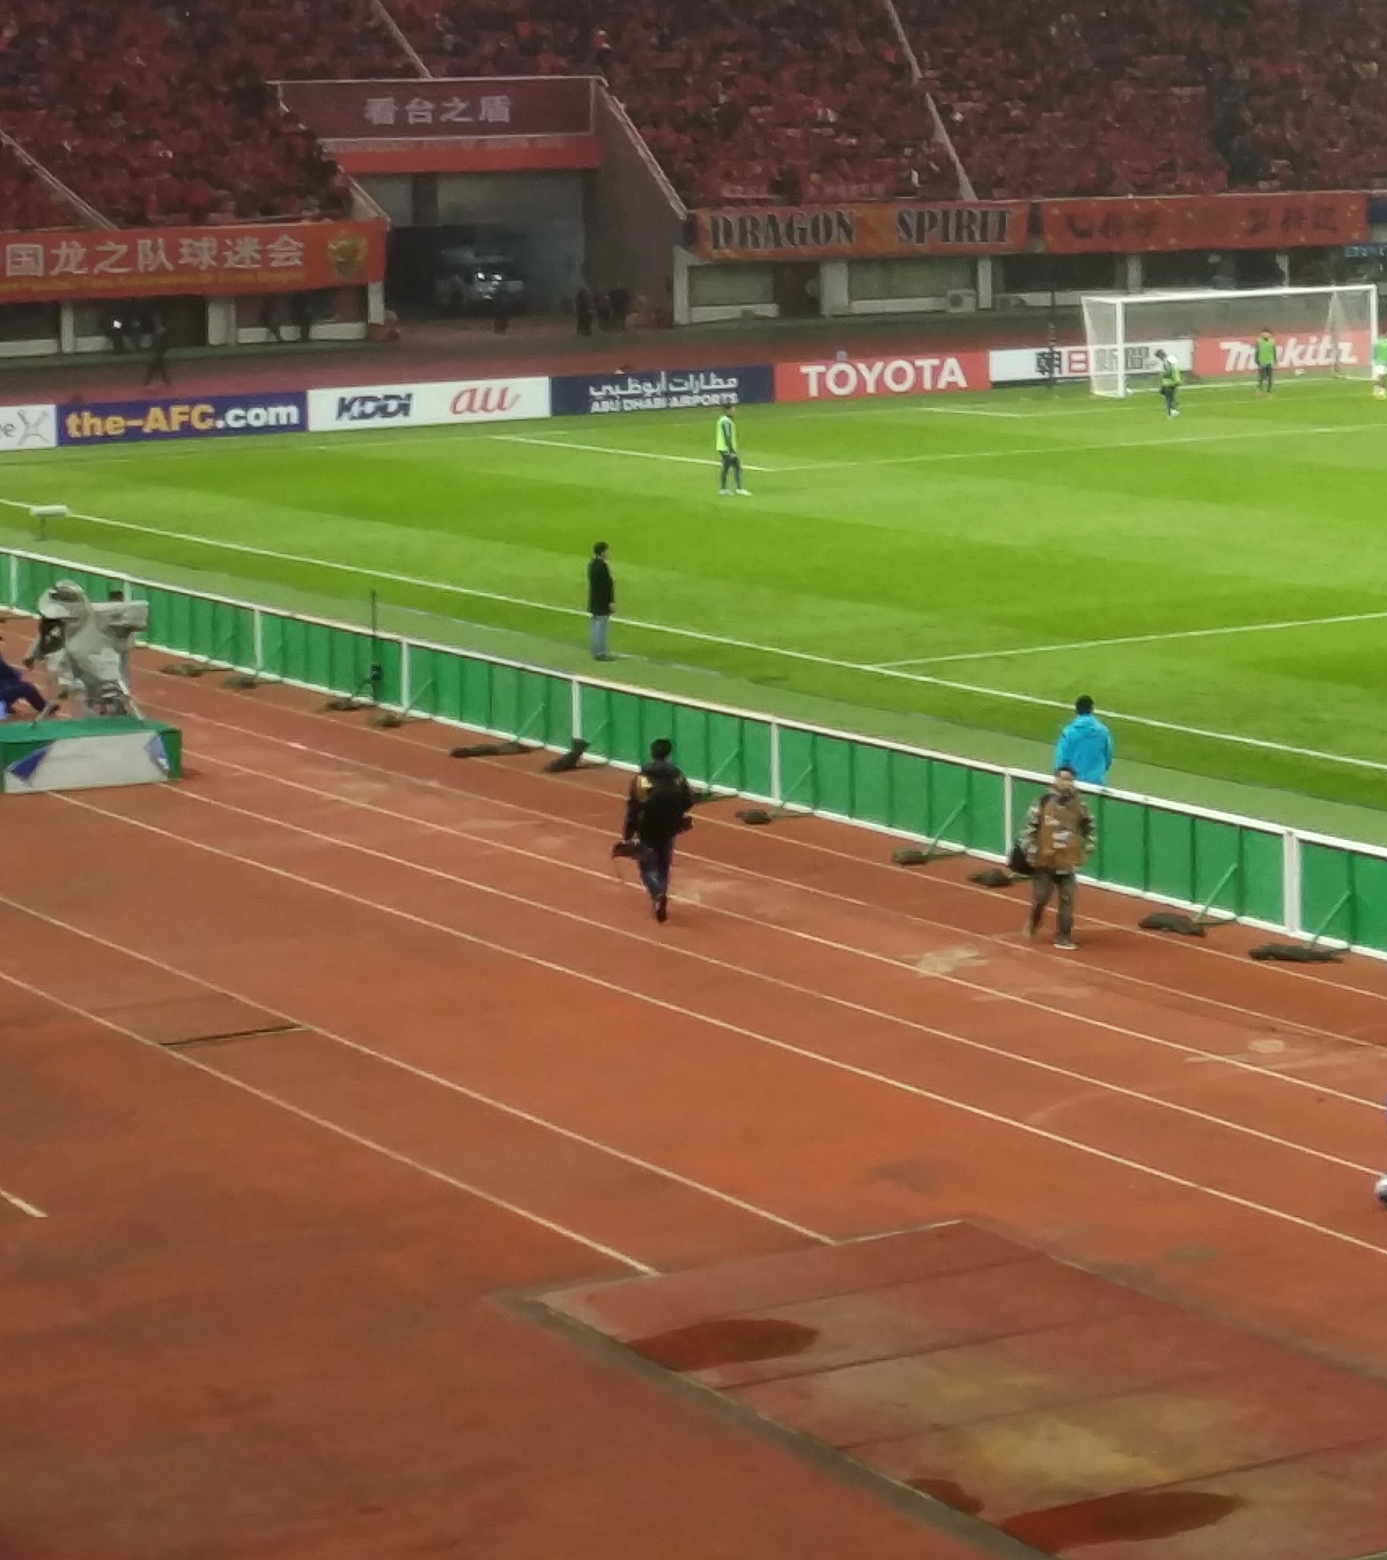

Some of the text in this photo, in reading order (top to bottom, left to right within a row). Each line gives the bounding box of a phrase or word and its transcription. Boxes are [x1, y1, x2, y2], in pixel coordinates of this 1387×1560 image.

[710, 209, 1012, 252] DRAGON SPIRIT
[1220, 338, 1358, 371] mkita
[800, 357, 968, 397] TOYOTA
[66, 403, 300, 438] the-AFC.com
[336, 385, 521, 421] KDDI au
